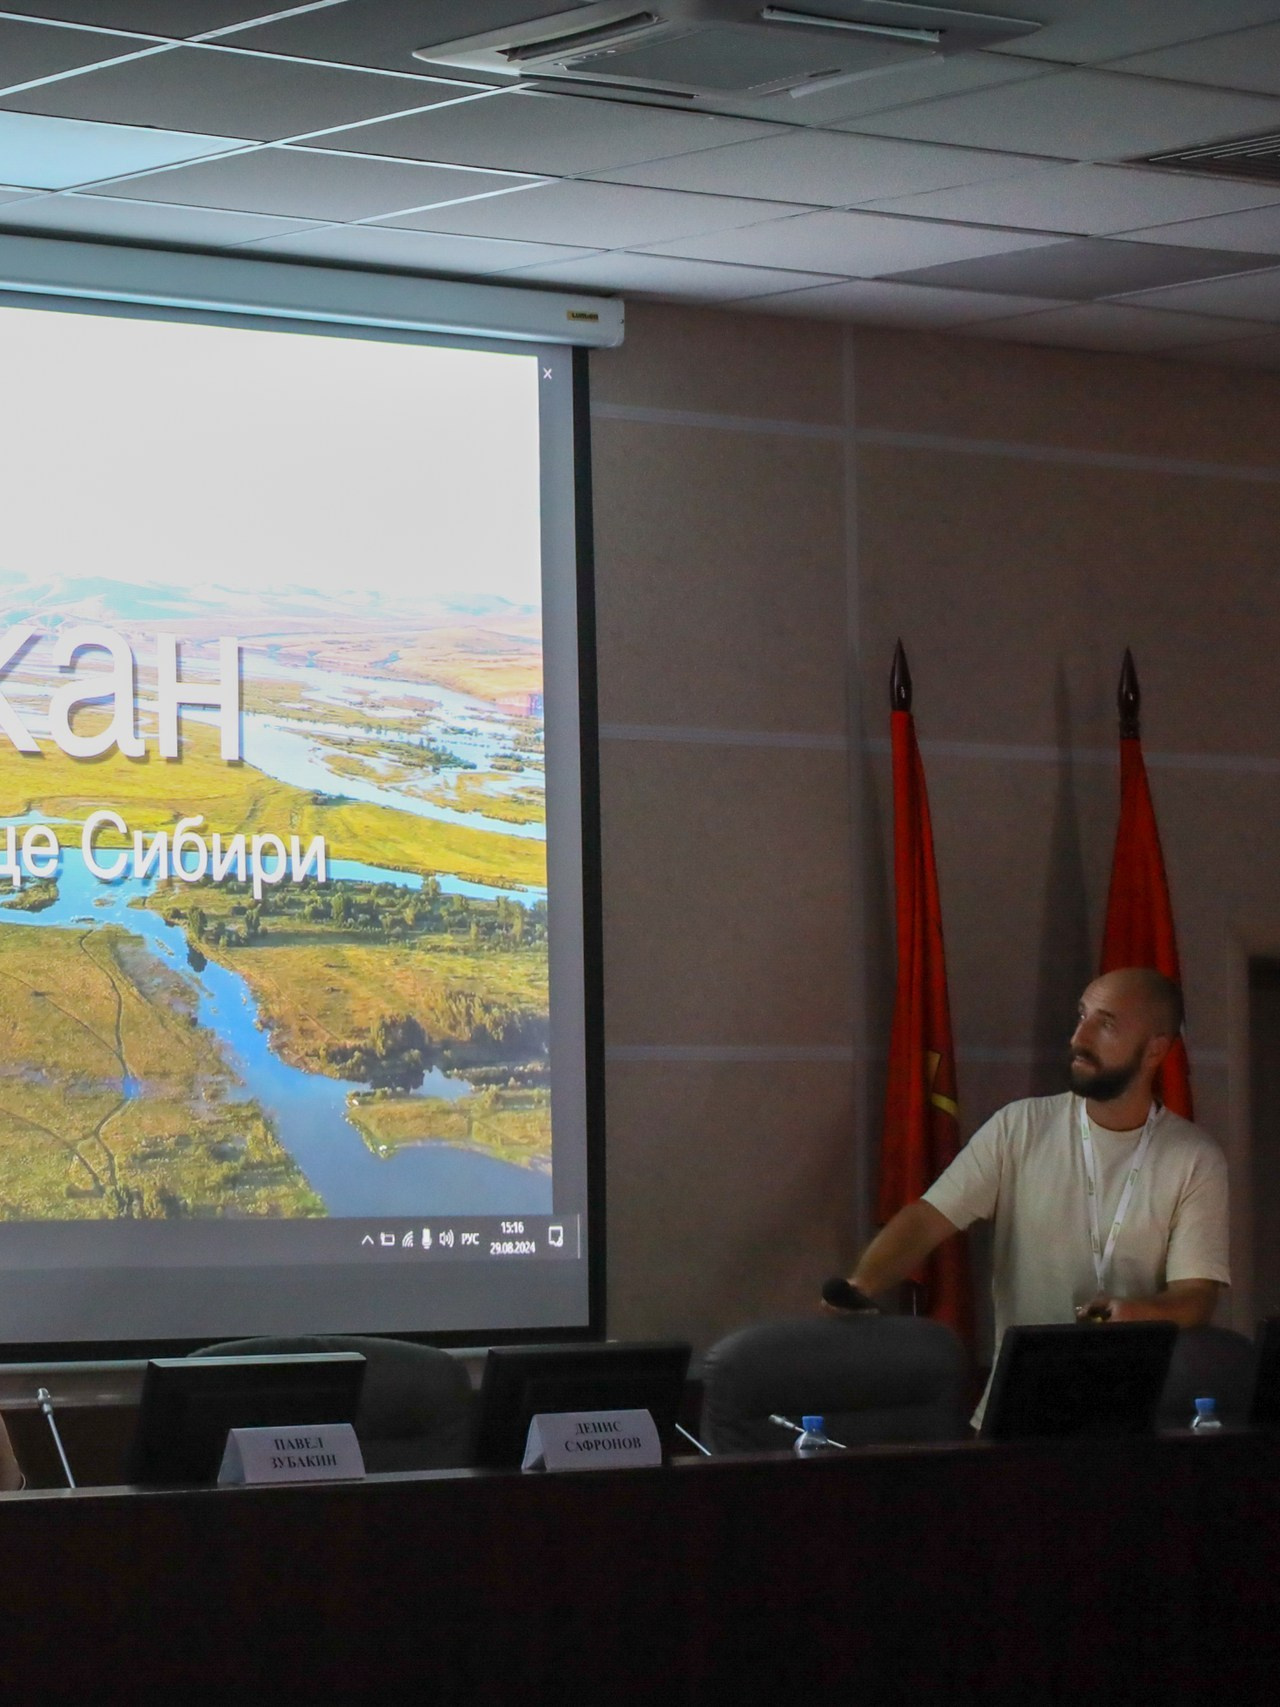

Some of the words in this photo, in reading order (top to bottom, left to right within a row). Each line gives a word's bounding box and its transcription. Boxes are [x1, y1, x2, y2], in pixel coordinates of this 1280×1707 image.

[81, 810, 329, 900] Сибири
[500, 1221, 525, 1235] 15:16
[461, 1232, 480, 1246] РУС
[489, 1241, 536, 1255] 29.08.2024
[575, 1421, 623, 1436] ДЕНИС
[274, 1437, 324, 1450] ПАВЕЛ
[564, 1437, 642, 1453] САФРОНОВ
[272, 1454, 337, 1469] ЗУБАКИН
